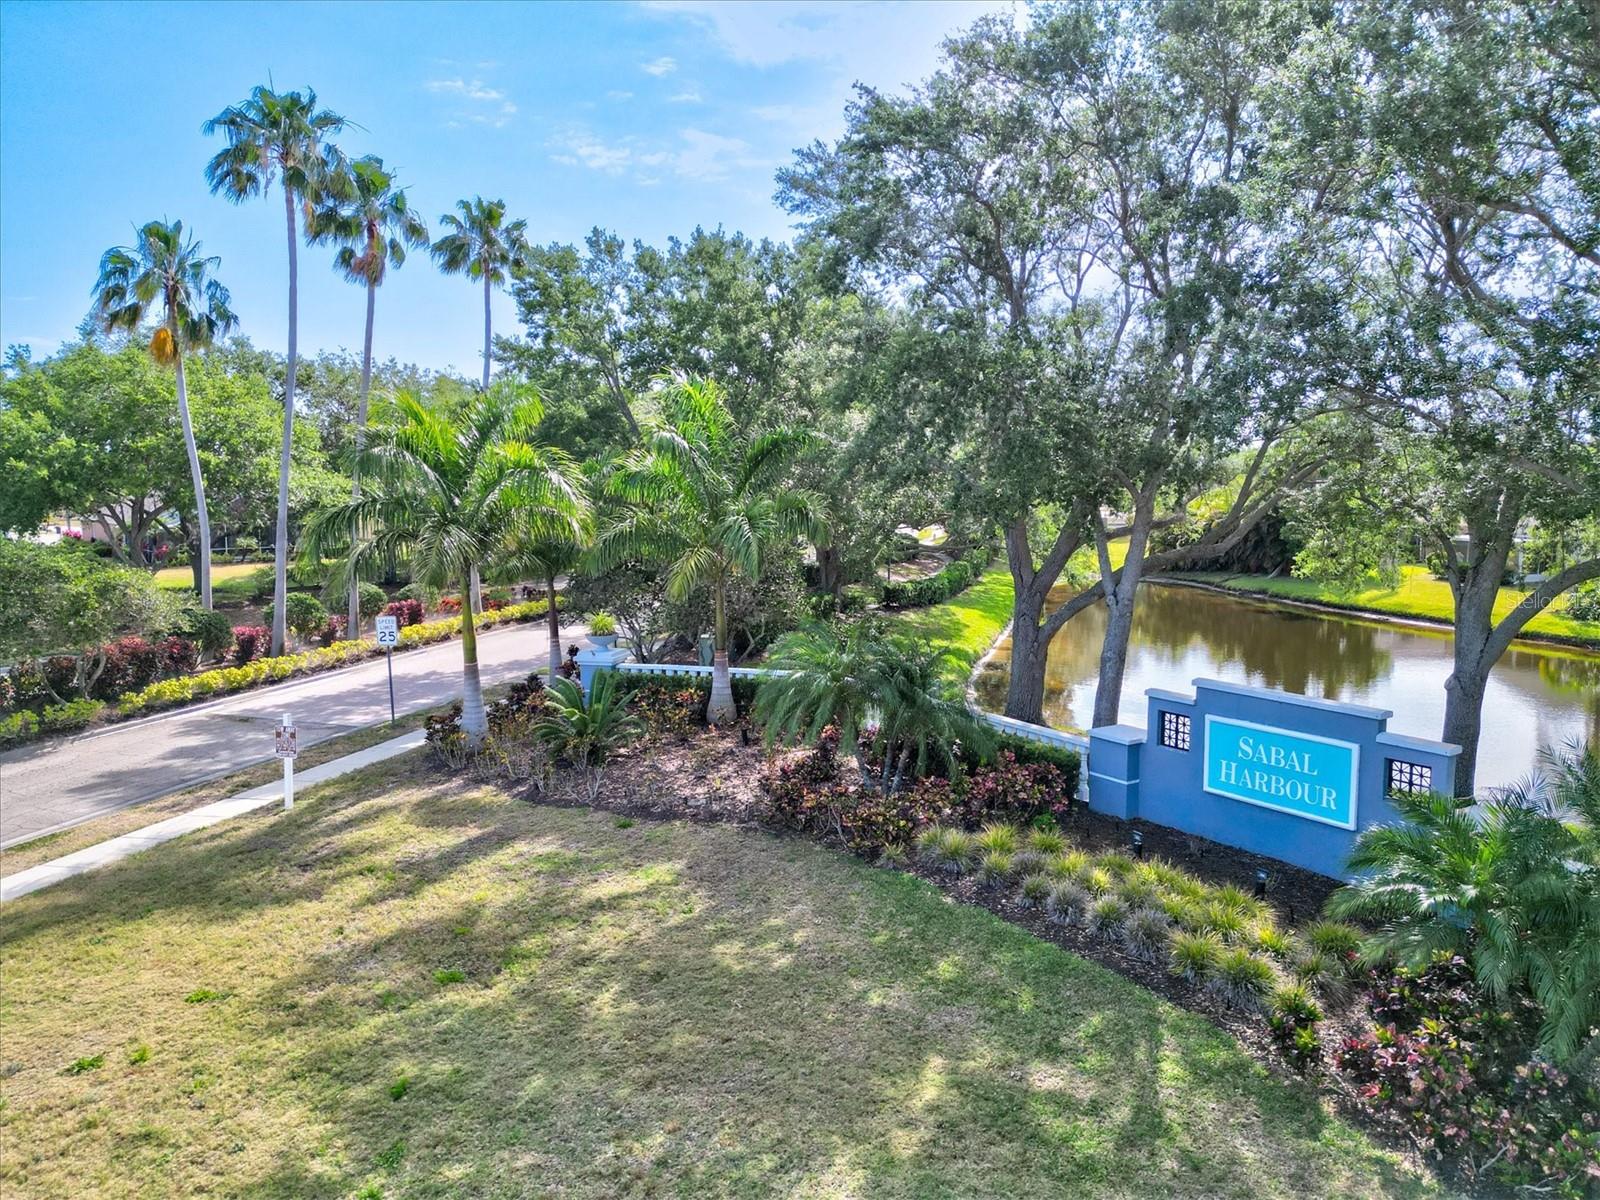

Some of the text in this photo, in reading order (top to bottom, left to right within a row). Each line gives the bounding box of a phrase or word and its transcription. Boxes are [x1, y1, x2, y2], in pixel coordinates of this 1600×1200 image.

[379, 631, 396, 642] 25
[1238, 736, 1318, 776] SABAL
[1218, 759, 1337, 810] HARBOUR
